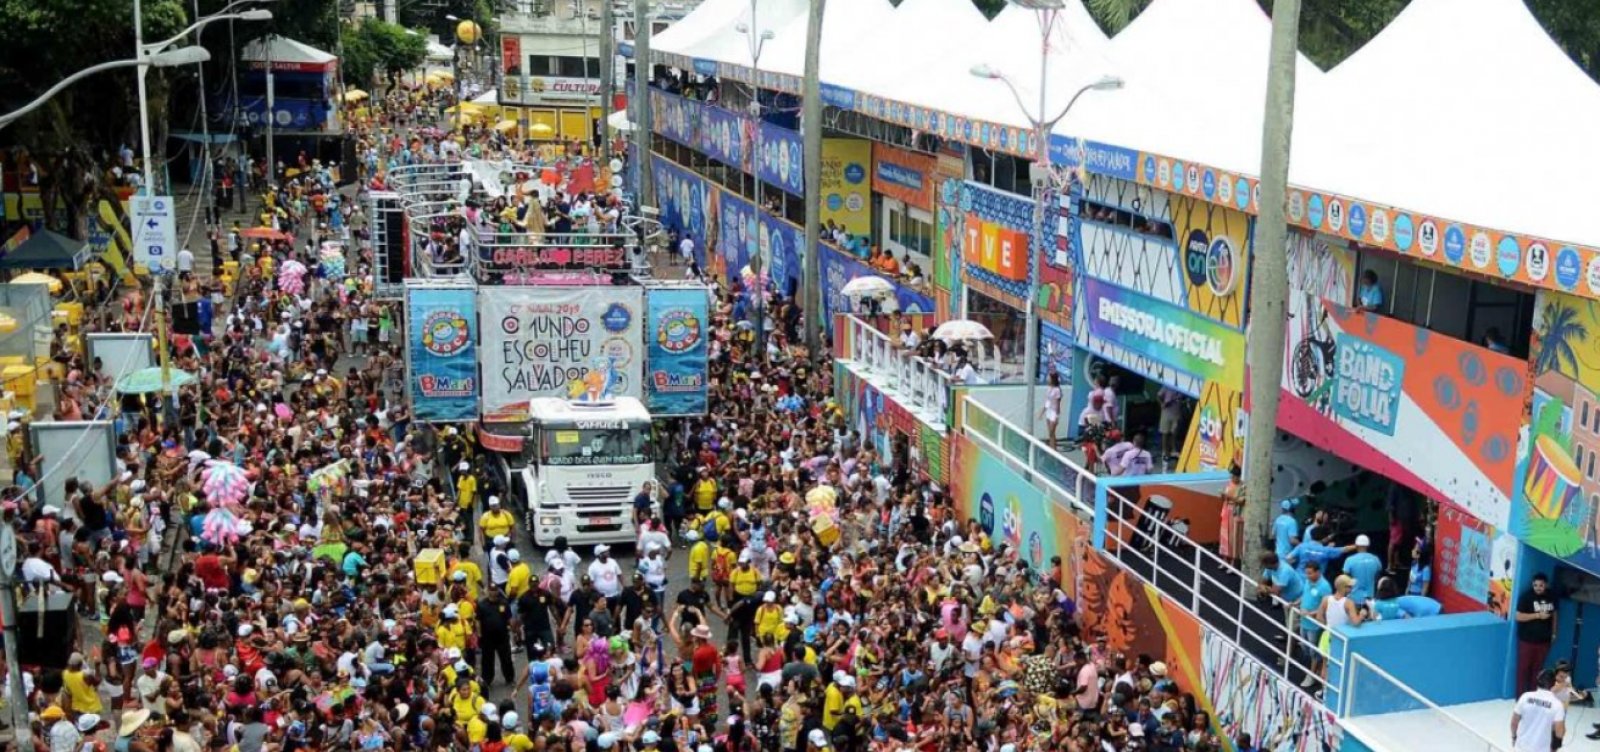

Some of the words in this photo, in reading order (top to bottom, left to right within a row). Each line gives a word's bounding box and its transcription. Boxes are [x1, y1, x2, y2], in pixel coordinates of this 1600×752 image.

[493, 248, 552, 265] CARLA
[573, 248, 624, 267] PEREZ
[969, 228, 1012, 268] TVE
[501, 316, 519, 335] O
[1098, 296, 1164, 343] EMISSORA
[1165, 322, 1225, 366] OFICIAL
[503, 339, 590, 366] ESCOLHEU
[1340, 344, 1395, 391] BAND
[502, 363, 590, 394] SALVADOR
[1337, 377, 1390, 426] FOLIA
[1200, 409, 1222, 441] sbt
[1003, 500, 1021, 541] sbt
